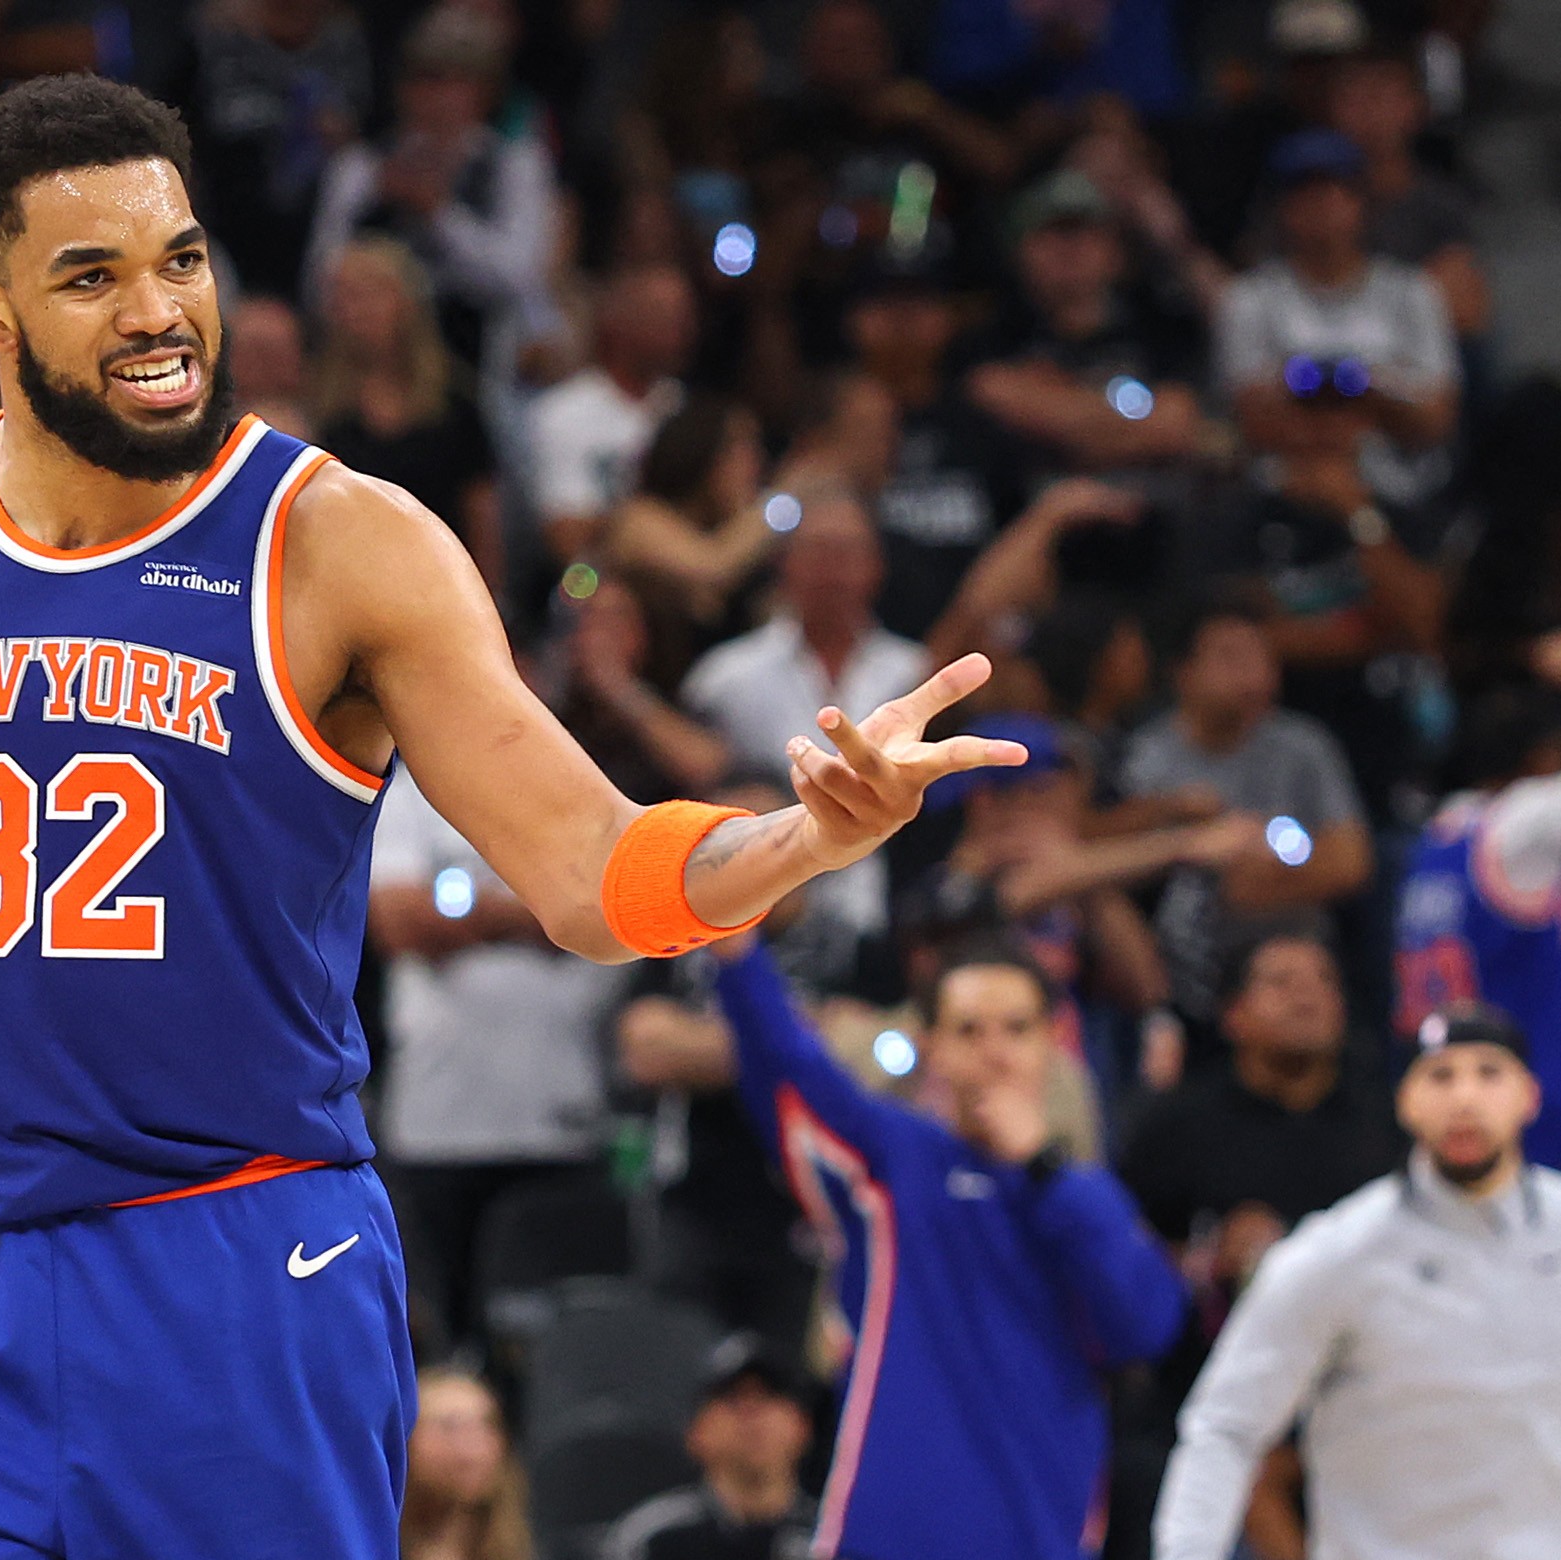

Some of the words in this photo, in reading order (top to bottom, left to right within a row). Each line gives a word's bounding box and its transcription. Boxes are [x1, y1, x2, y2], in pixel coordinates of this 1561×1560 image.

[144, 561, 198, 572] experience
[140, 571, 179, 587] abu
[182, 574, 242, 595] dhabi
[36, 637, 237, 756] YORK
